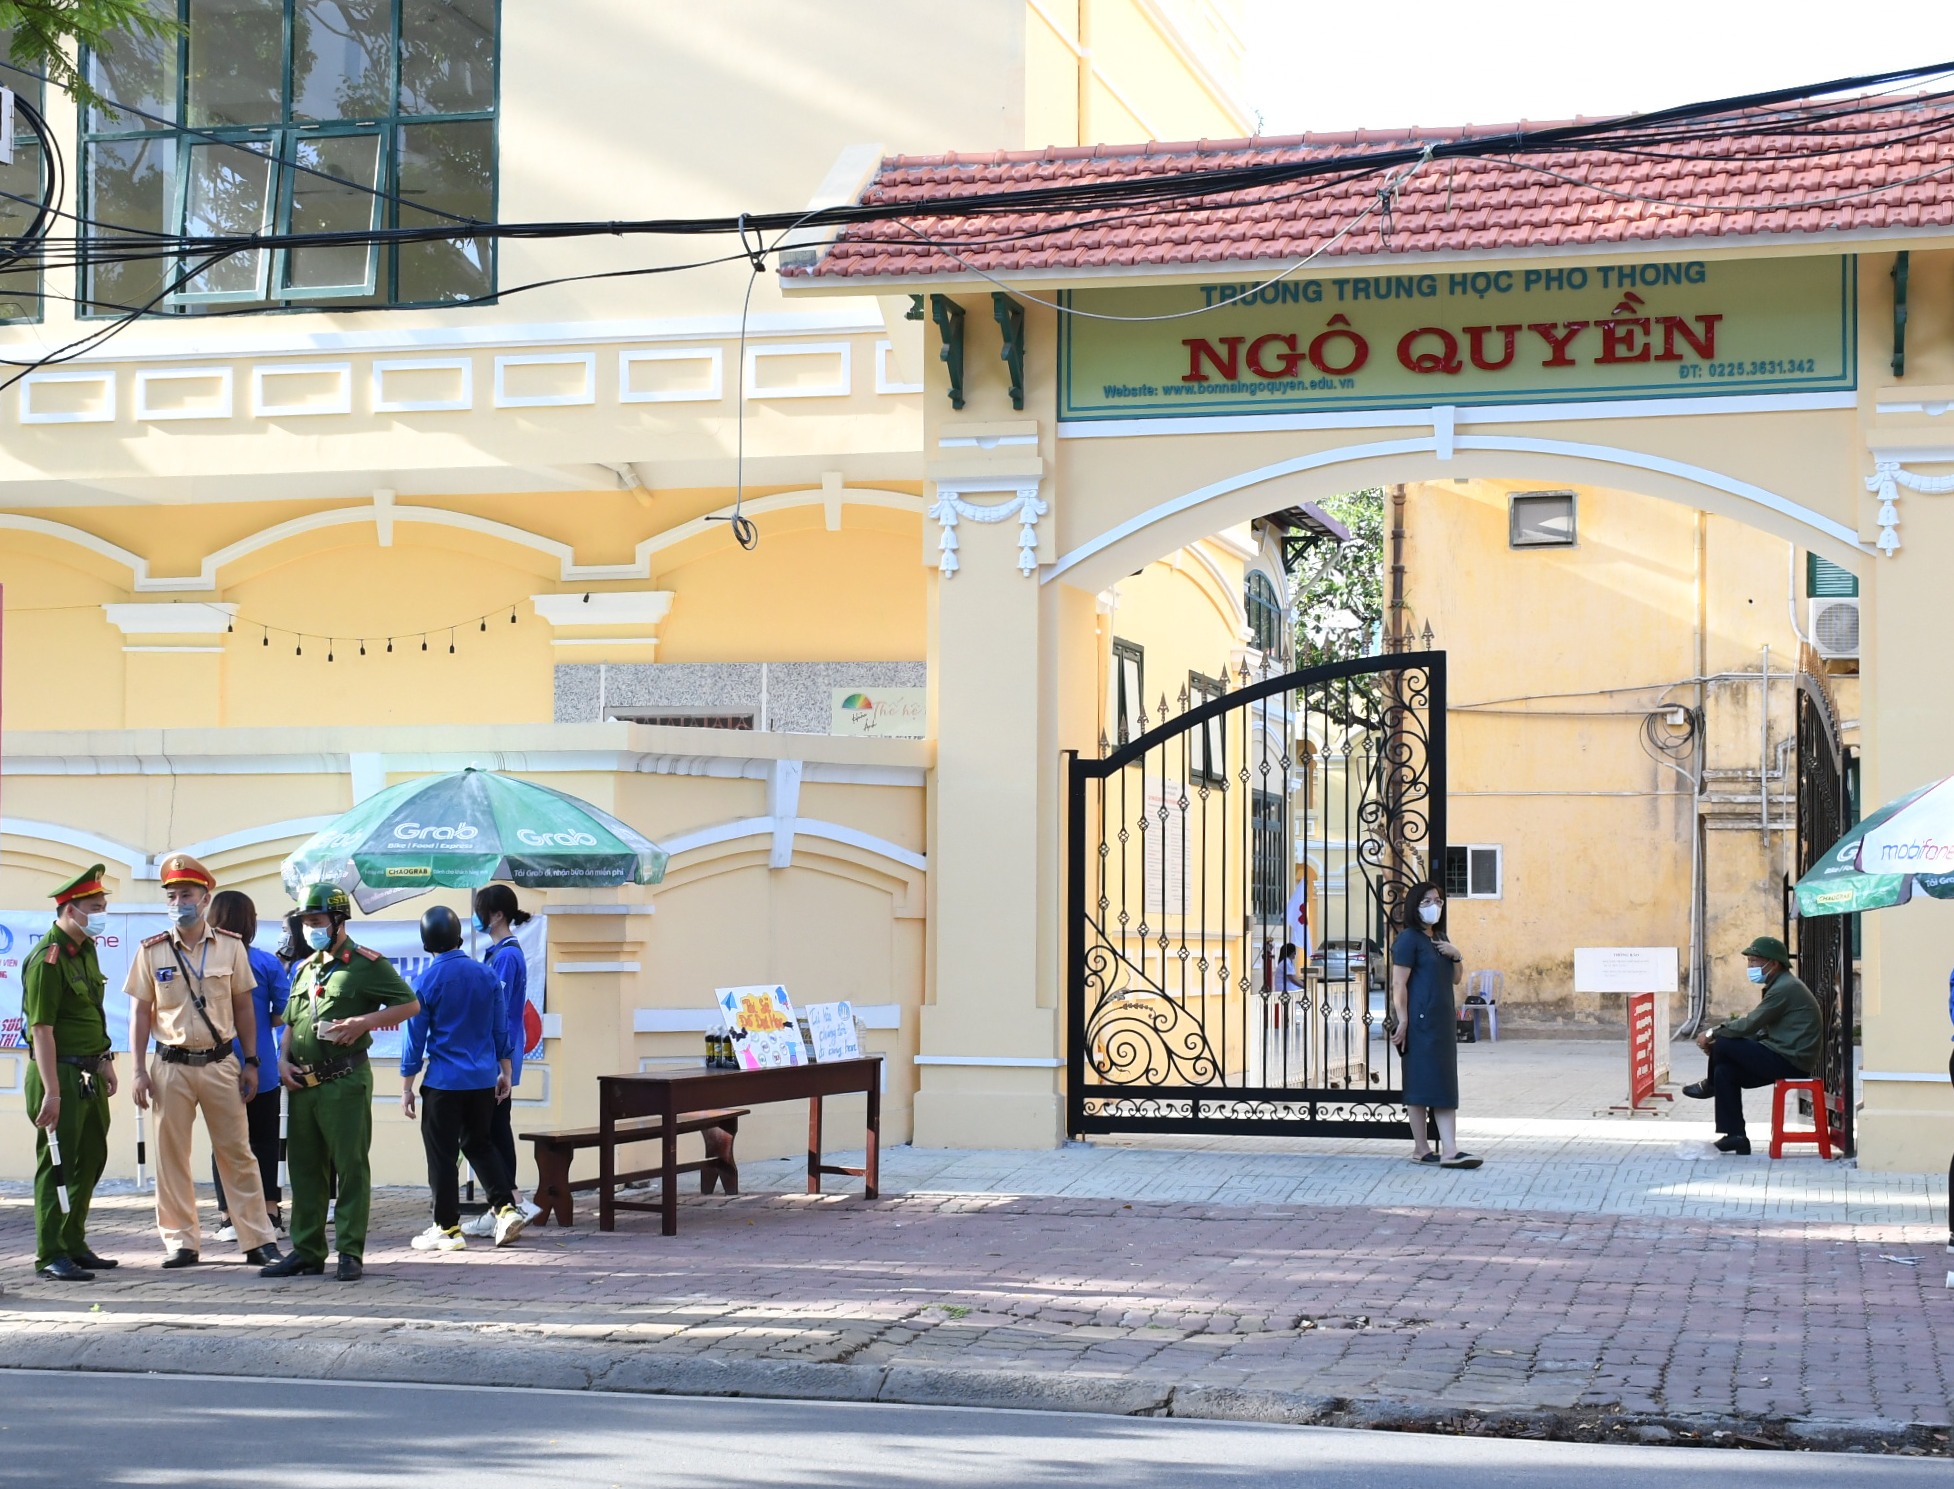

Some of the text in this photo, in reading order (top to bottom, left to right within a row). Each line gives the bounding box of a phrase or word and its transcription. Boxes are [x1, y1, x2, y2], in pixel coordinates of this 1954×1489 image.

[1332, 274, 1437, 301] TRUNG
[1449, 270, 1513, 299] HỌC
[1181, 291, 1723, 382] NGÔ QUYỀN
[1679, 359, 1815, 379] ĐT: 0225.3631.342
[1104, 384, 1158, 398] Website:
[394, 821, 478, 840] Grab
[517, 828, 597, 847] Grab
